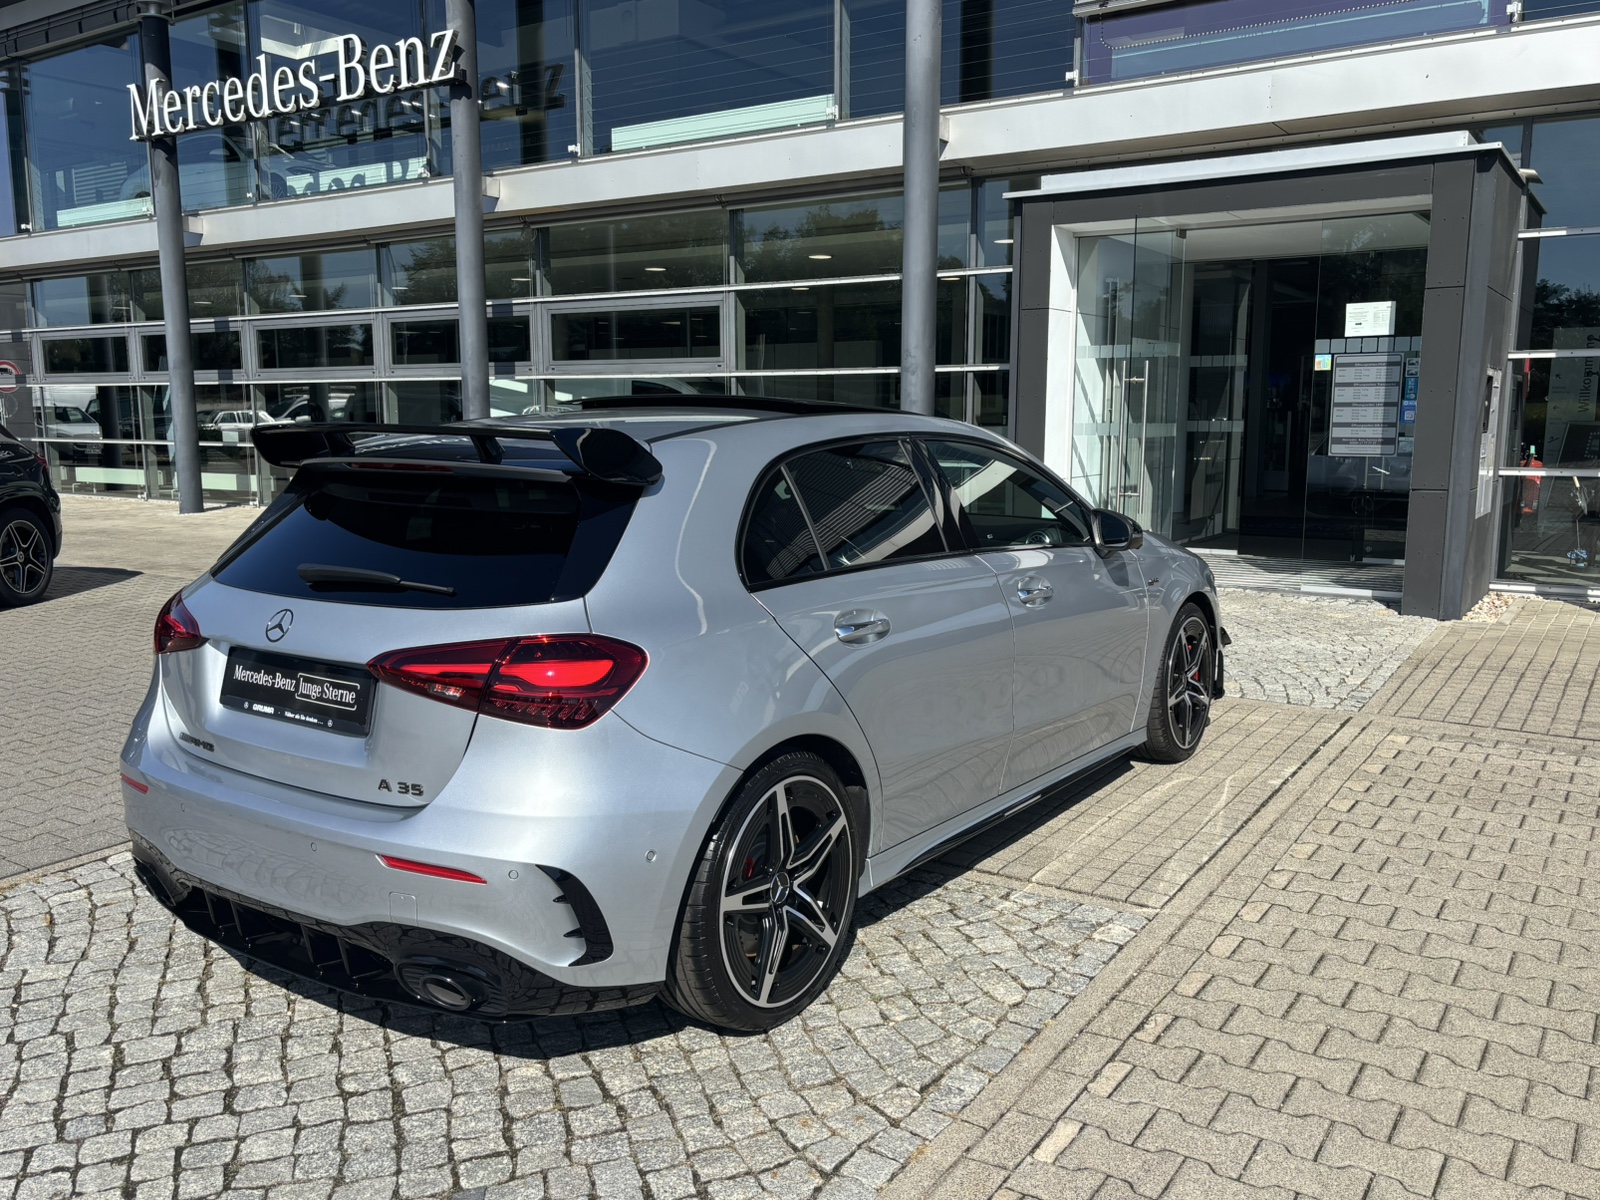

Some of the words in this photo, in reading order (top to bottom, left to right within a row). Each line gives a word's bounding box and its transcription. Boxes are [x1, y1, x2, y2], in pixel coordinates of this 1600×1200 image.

[127, 29, 457, 141] Mercedes-Benz
[233, 664, 296, 691] Mercedes-Benz
[298, 677, 322, 699] Junge
[323, 682, 356, 704] Sterne
[378, 778, 393, 793] A
[397, 781, 424, 797] 35
